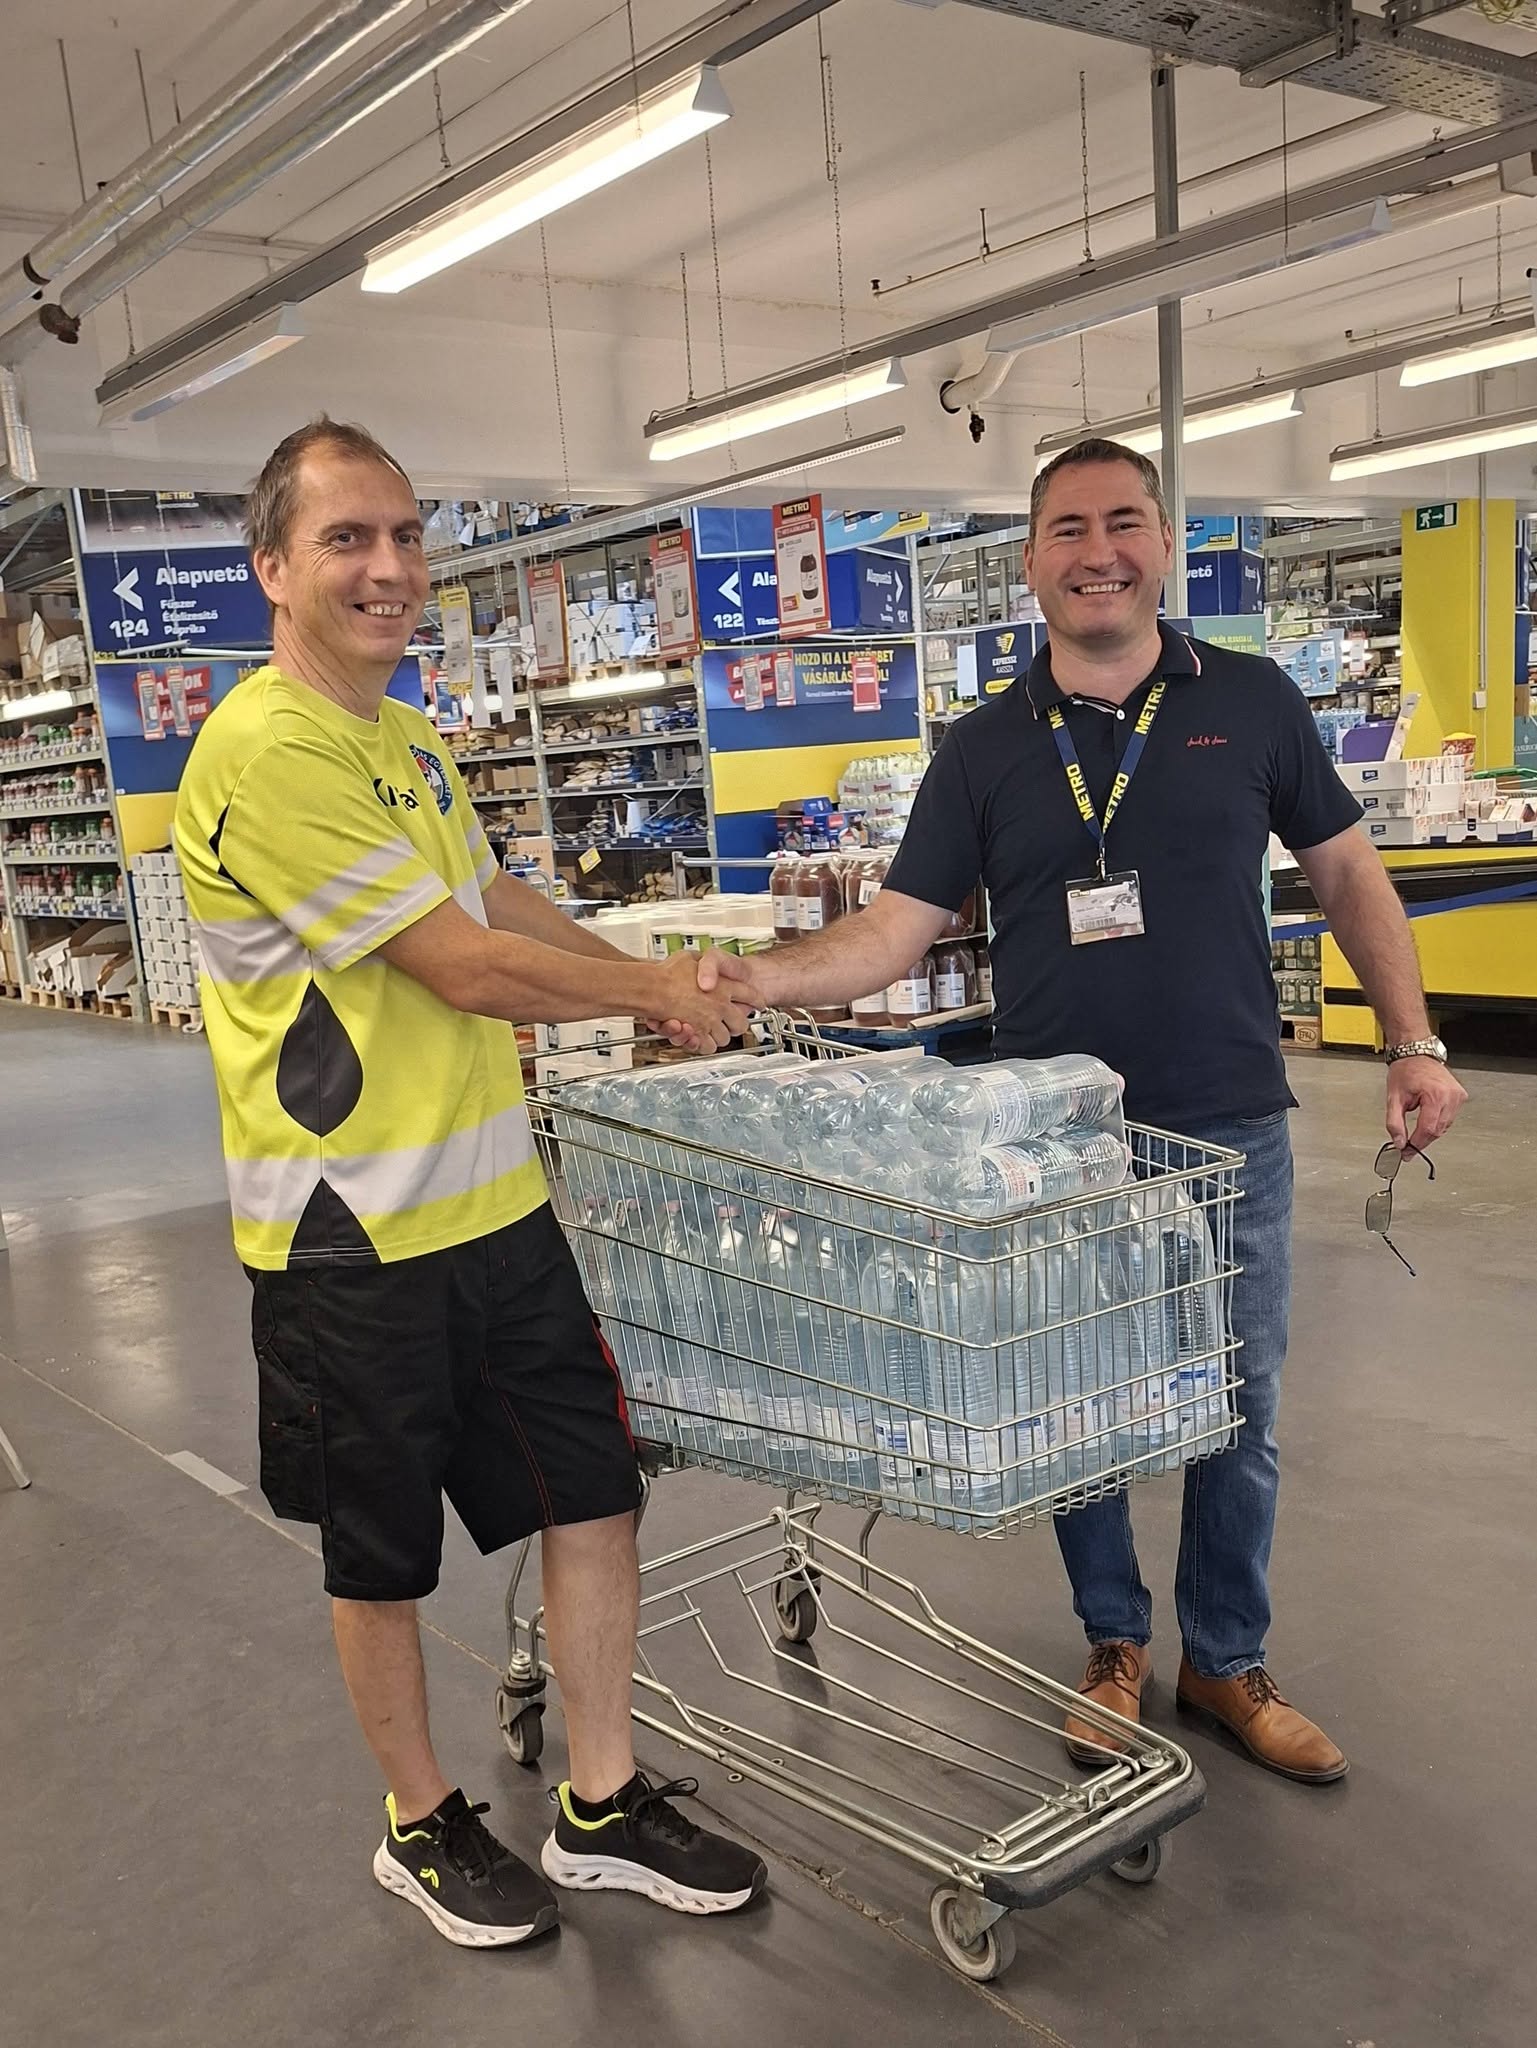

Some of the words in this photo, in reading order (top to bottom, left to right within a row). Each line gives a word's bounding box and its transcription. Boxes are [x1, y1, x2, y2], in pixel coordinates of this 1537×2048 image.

[158, 491, 196, 501] METRO
[782, 502, 810, 516] METRO
[658, 535, 681, 549] METRO
[155, 564, 249, 588] Alapvető
[752, 571, 778, 587] Ala
[1187, 564, 1213, 579] vető
[109, 618, 149, 638] 124
[713, 613, 744, 629] 122
[795, 653, 820, 666] HOZD
[822, 652, 832, 665] KI
[834, 652, 841, 664] A
[1134, 681, 1167, 736] METRO
[1049, 705, 1065, 730] ME
[1066, 762, 1096, 822] METRO
[1102, 772, 1130, 834] METRO
[954, 1478, 966, 1488] 1,5
